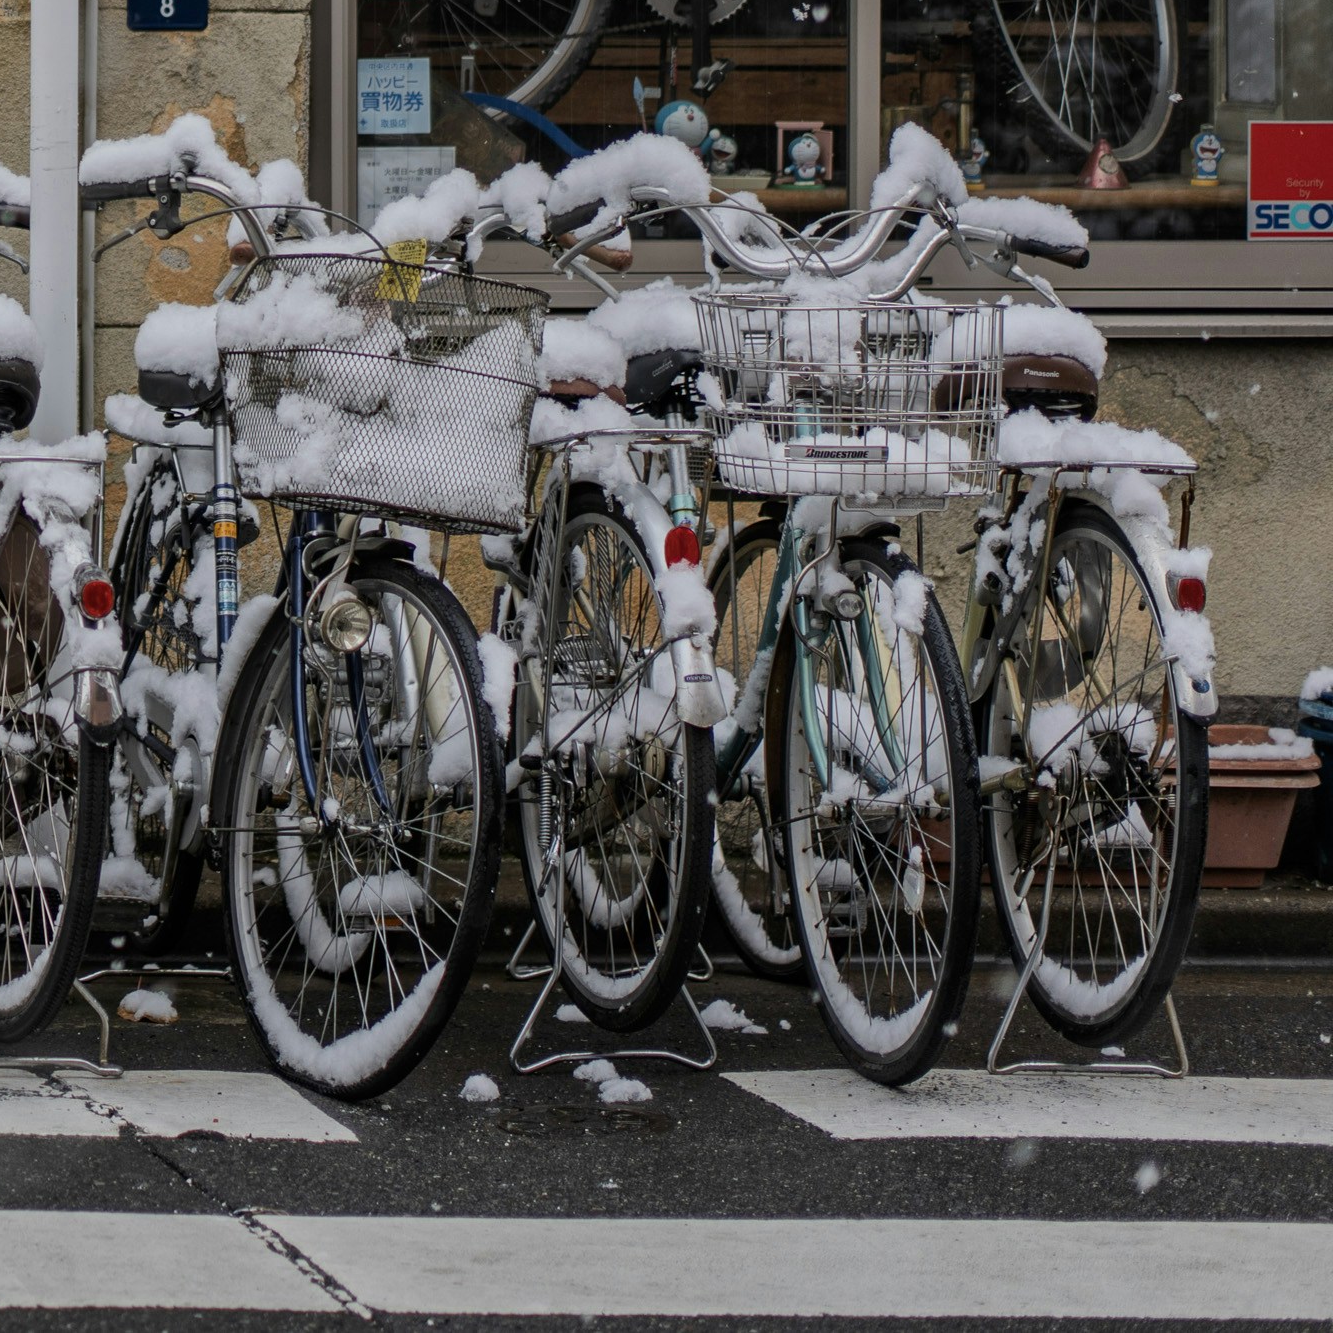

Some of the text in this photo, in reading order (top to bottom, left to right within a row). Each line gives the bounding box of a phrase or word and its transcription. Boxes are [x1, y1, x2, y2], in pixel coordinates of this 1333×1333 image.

[367, 75, 419, 89] ハッピー
[360, 91, 424, 113] 買物券
[1286, 177, 1324, 189] Security
[1299, 188, 1311, 200] by
[1255, 203, 1333, 230] SECO
[1024, 368, 1060, 378] Panasonic
[805, 448, 869, 458] BRIDGESTONE
